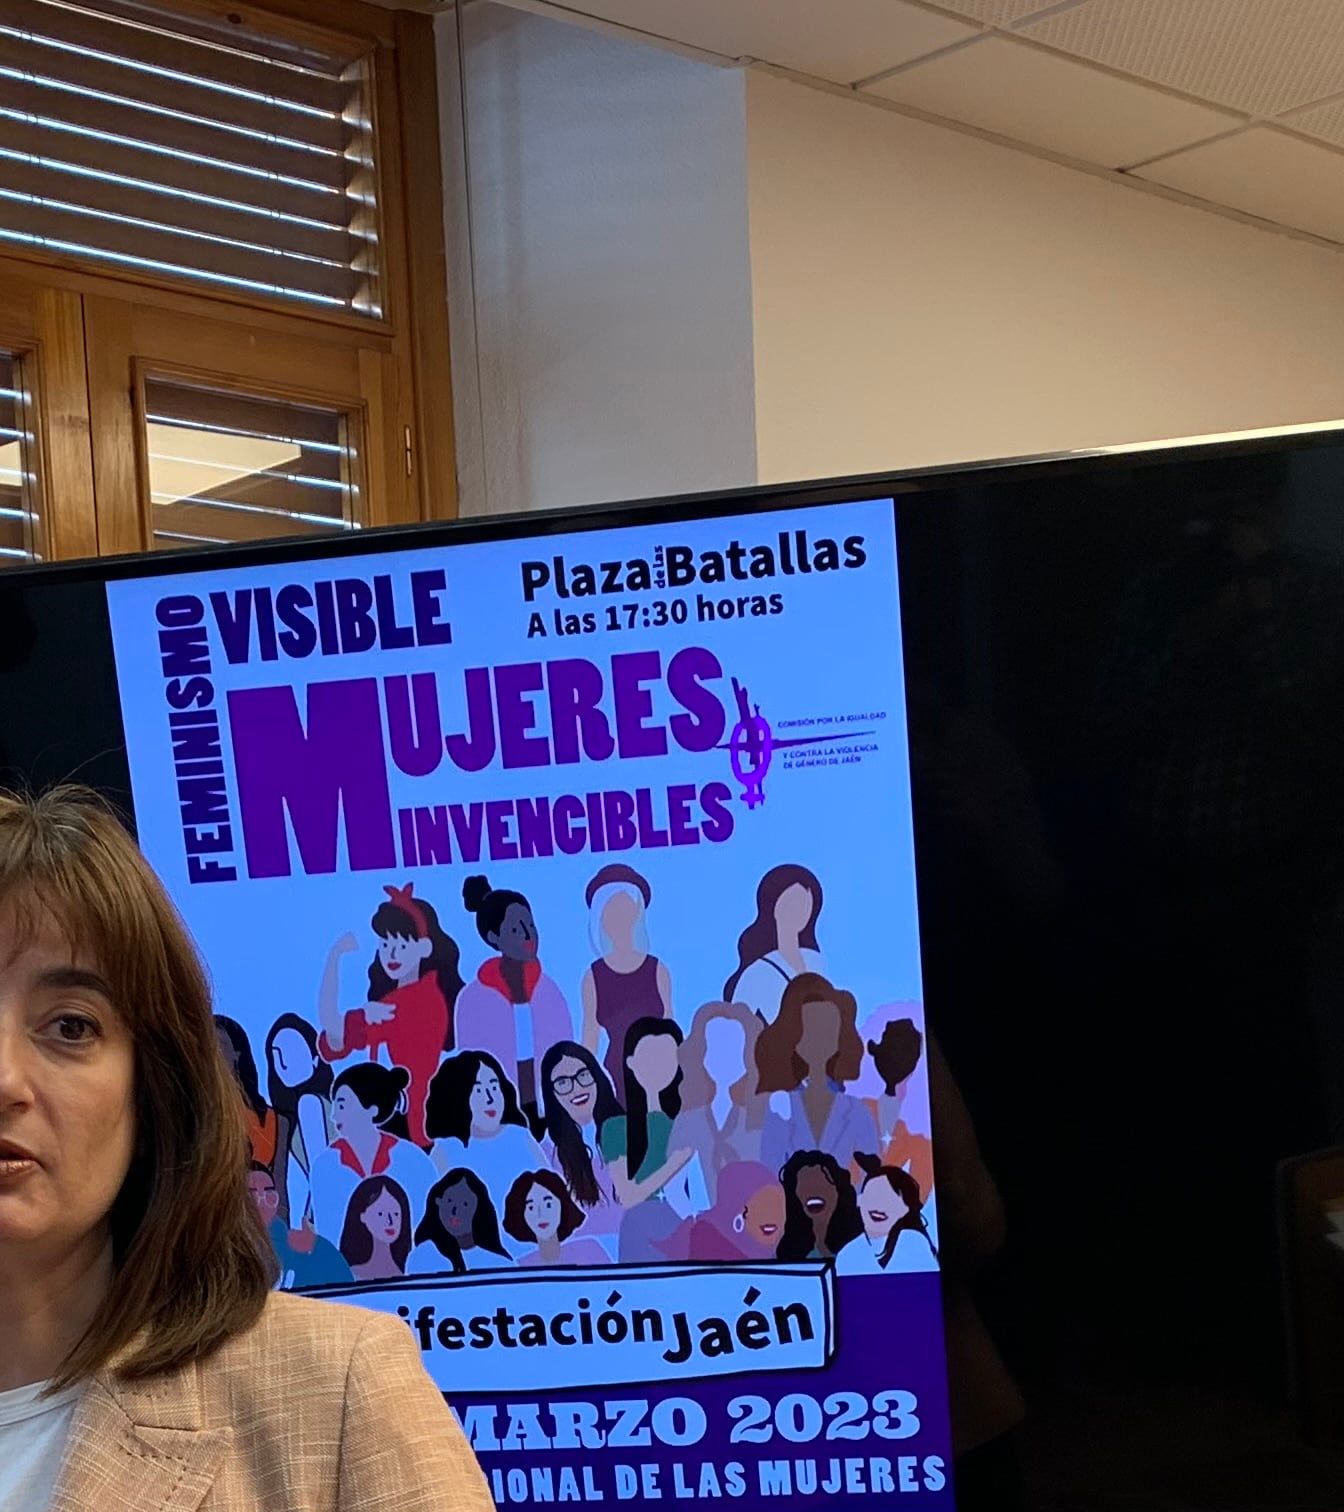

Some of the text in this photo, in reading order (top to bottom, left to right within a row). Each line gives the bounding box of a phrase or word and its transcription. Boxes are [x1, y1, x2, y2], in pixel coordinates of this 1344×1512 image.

[522, 555, 651, 601] Plaza
[666, 530, 867, 587] Batallas
[209, 569, 452, 664] VISIBLE
[527, 594, 784, 638] A las 17:30 horas
[156, 595, 237, 884] FEMINISMO
[226, 647, 726, 879] MUJERES
[398, 782, 735, 867] INVENCIBLES
[662, 1286, 815, 1363] Jaén
[449, 1390, 921, 1451] MARZO 2023
[615, 1464, 666, 1500] DE
[673, 1461, 746, 1499] LAS
[758, 1456, 946, 1497] MUJERES
